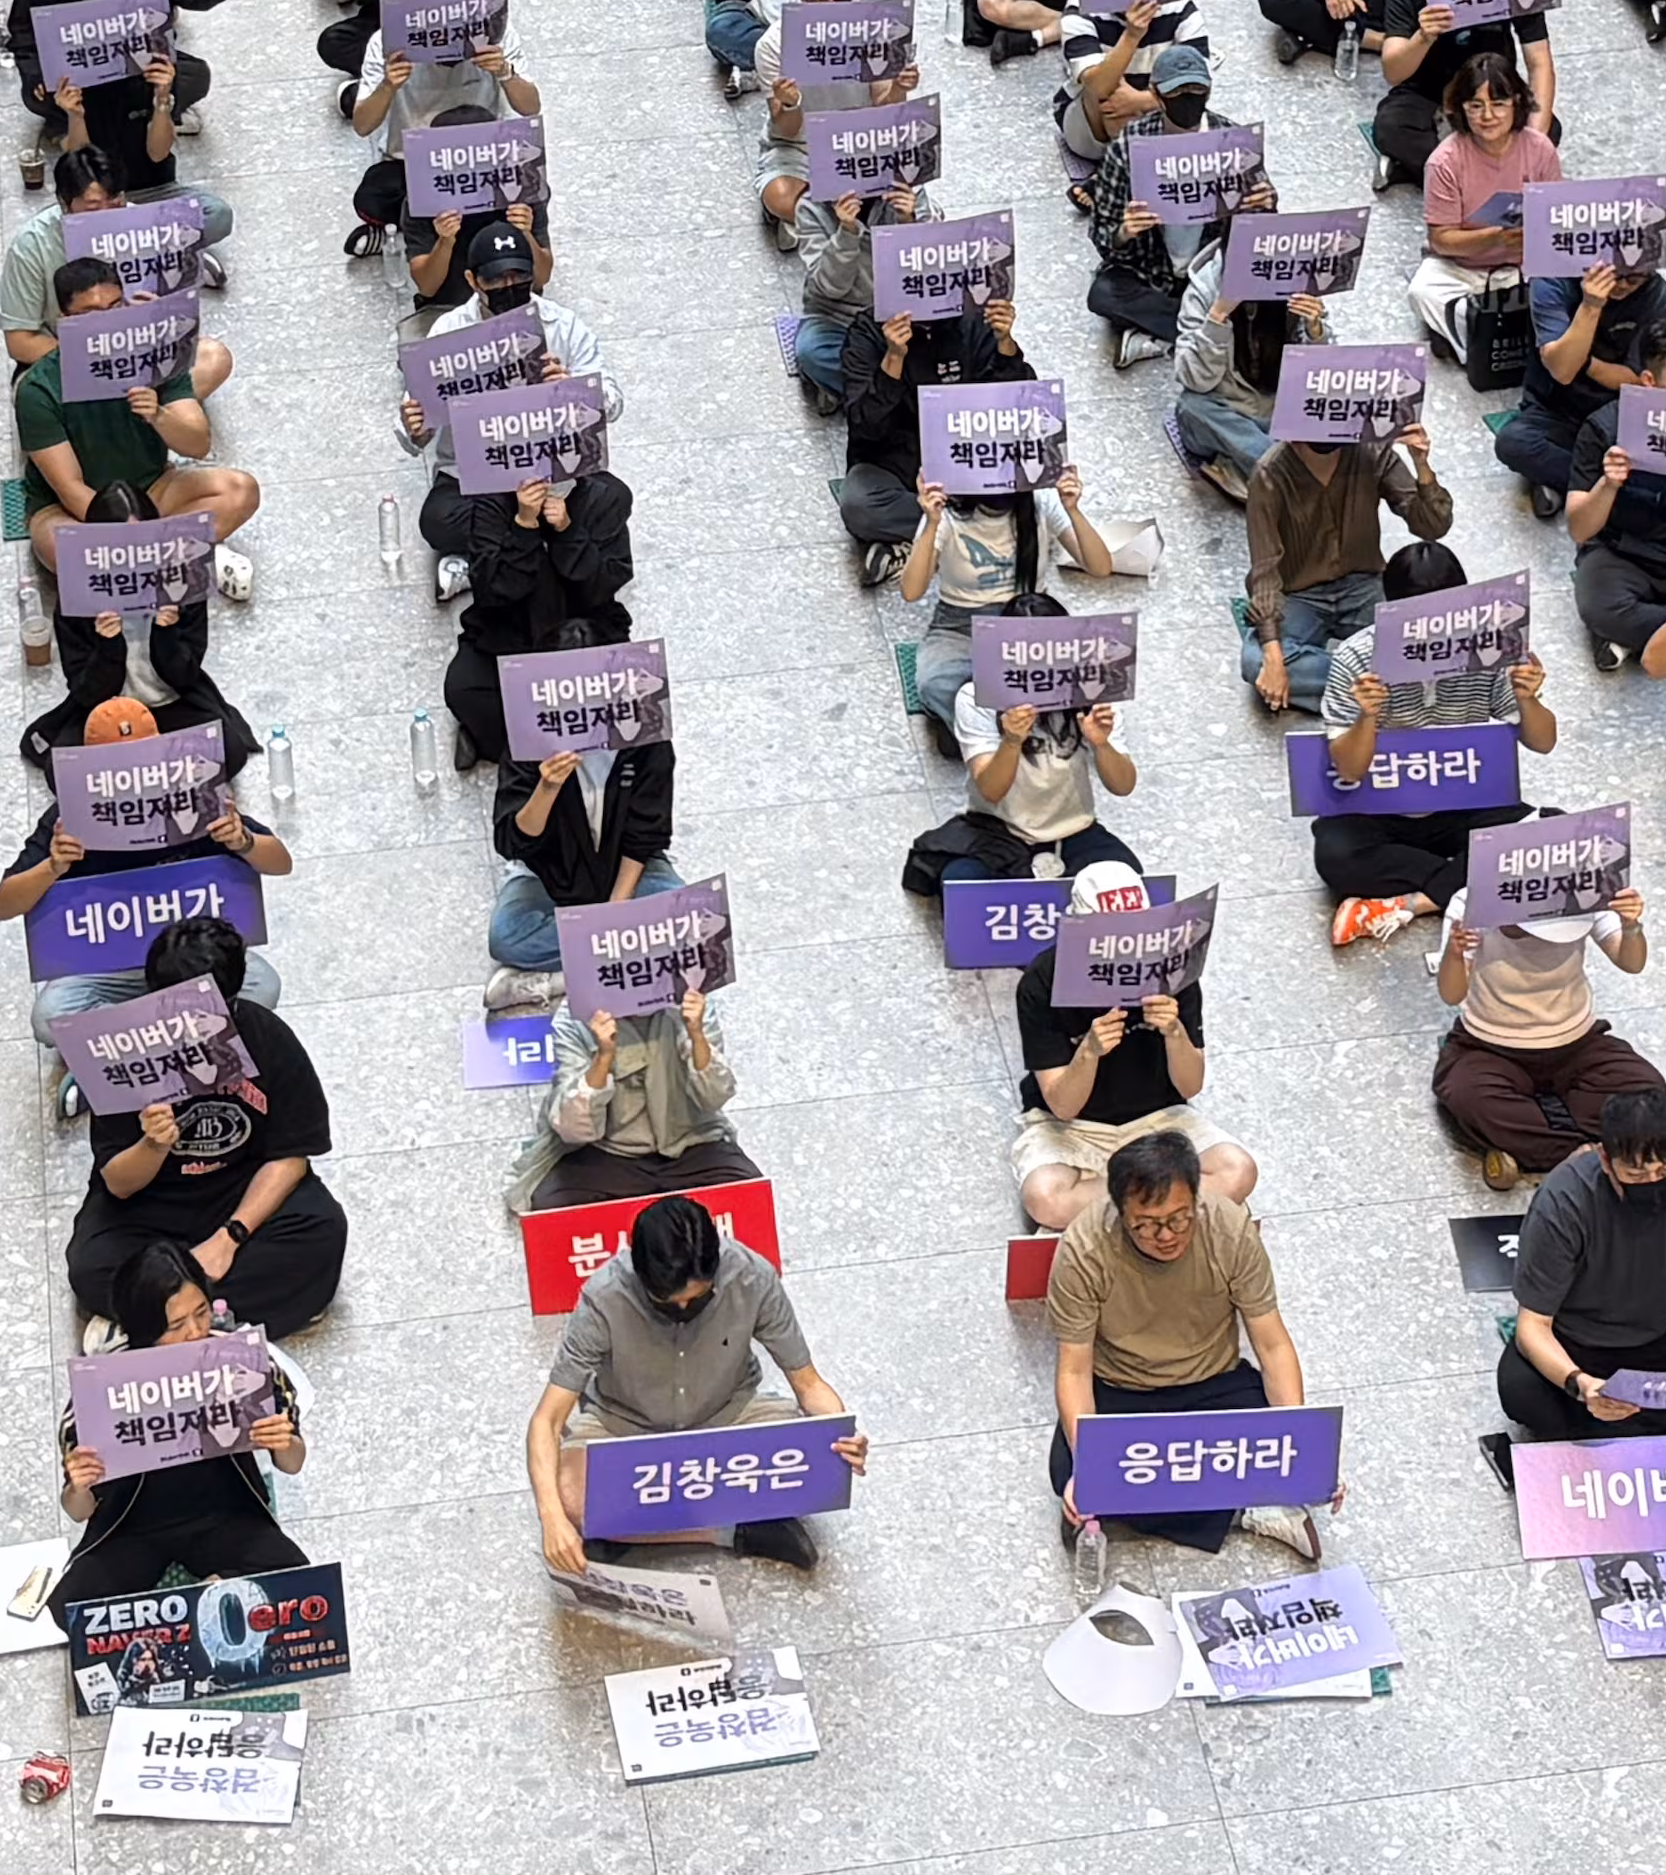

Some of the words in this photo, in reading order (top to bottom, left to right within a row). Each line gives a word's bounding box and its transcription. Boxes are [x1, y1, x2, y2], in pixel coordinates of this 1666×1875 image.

[60, 9, 147, 45] 네이버가
[805, 19, 892, 41] 네이버가
[65, 35, 153, 68] 책임져라
[430, 140, 519, 170] 네이버가
[832, 124, 919, 153] 네이버가
[433, 165, 521, 195] 책임져라
[1550, 199, 1645, 227] 네이버가
[91, 224, 181, 256] 네이버가
[899, 237, 991, 270] 네이버가
[1253, 229, 1342, 257] 네이버가
[1552, 226, 1644, 255] 책임져라
[119, 253, 184, 286] 임져라
[901, 266, 992, 297] 책임져라
[87, 317, 178, 356] 네이버가
[89, 345, 178, 381] 책임져라
[429, 335, 521, 380] 네이버가
[1306, 369, 1404, 393] 네이버가
[479, 405, 578, 440] 네이버가
[947, 407, 1043, 436] 네이버가
[1302, 396, 1397, 423] 책임져라
[484, 434, 582, 469] 책임져라
[950, 440, 1044, 467] 책임져라
[84, 539, 185, 567] 네이버가
[87, 565, 188, 596] 책임져라
[1403, 603, 1502, 641] 네이버가
[1001, 639, 1106, 665] 네이버가
[1402, 631, 1502, 661] 책임져라
[532, 669, 637, 705] 네이버가
[1004, 665, 1105, 691] 책임져라
[536, 703, 641, 734] 책임져라
[85, 756, 197, 795] 네이버가
[91, 790, 198, 826] 책임져라
[1498, 836, 1602, 875] 네이버가
[1498, 869, 1603, 901] 책임져라
[64, 883, 225, 945] 네이버가
[591, 912, 700, 960] 네이버가
[1089, 920, 1192, 957] 네이버가
[597, 945, 706, 990] 책임져라
[1087, 956, 1189, 986] 책임져라
[87, 1014, 198, 1061] 네이버가
[103, 1045, 212, 1090] 책임져라
[107, 1366, 235, 1414] 네이버가
[114, 1403, 239, 1446] 책임져라
[632, 1448, 810, 1505] 김창욱은
[1118, 1435, 1298, 1485] 응답하라
[83, 1595, 189, 1636] ZERO
[1239, 1628, 1360, 1672] 네이버가
